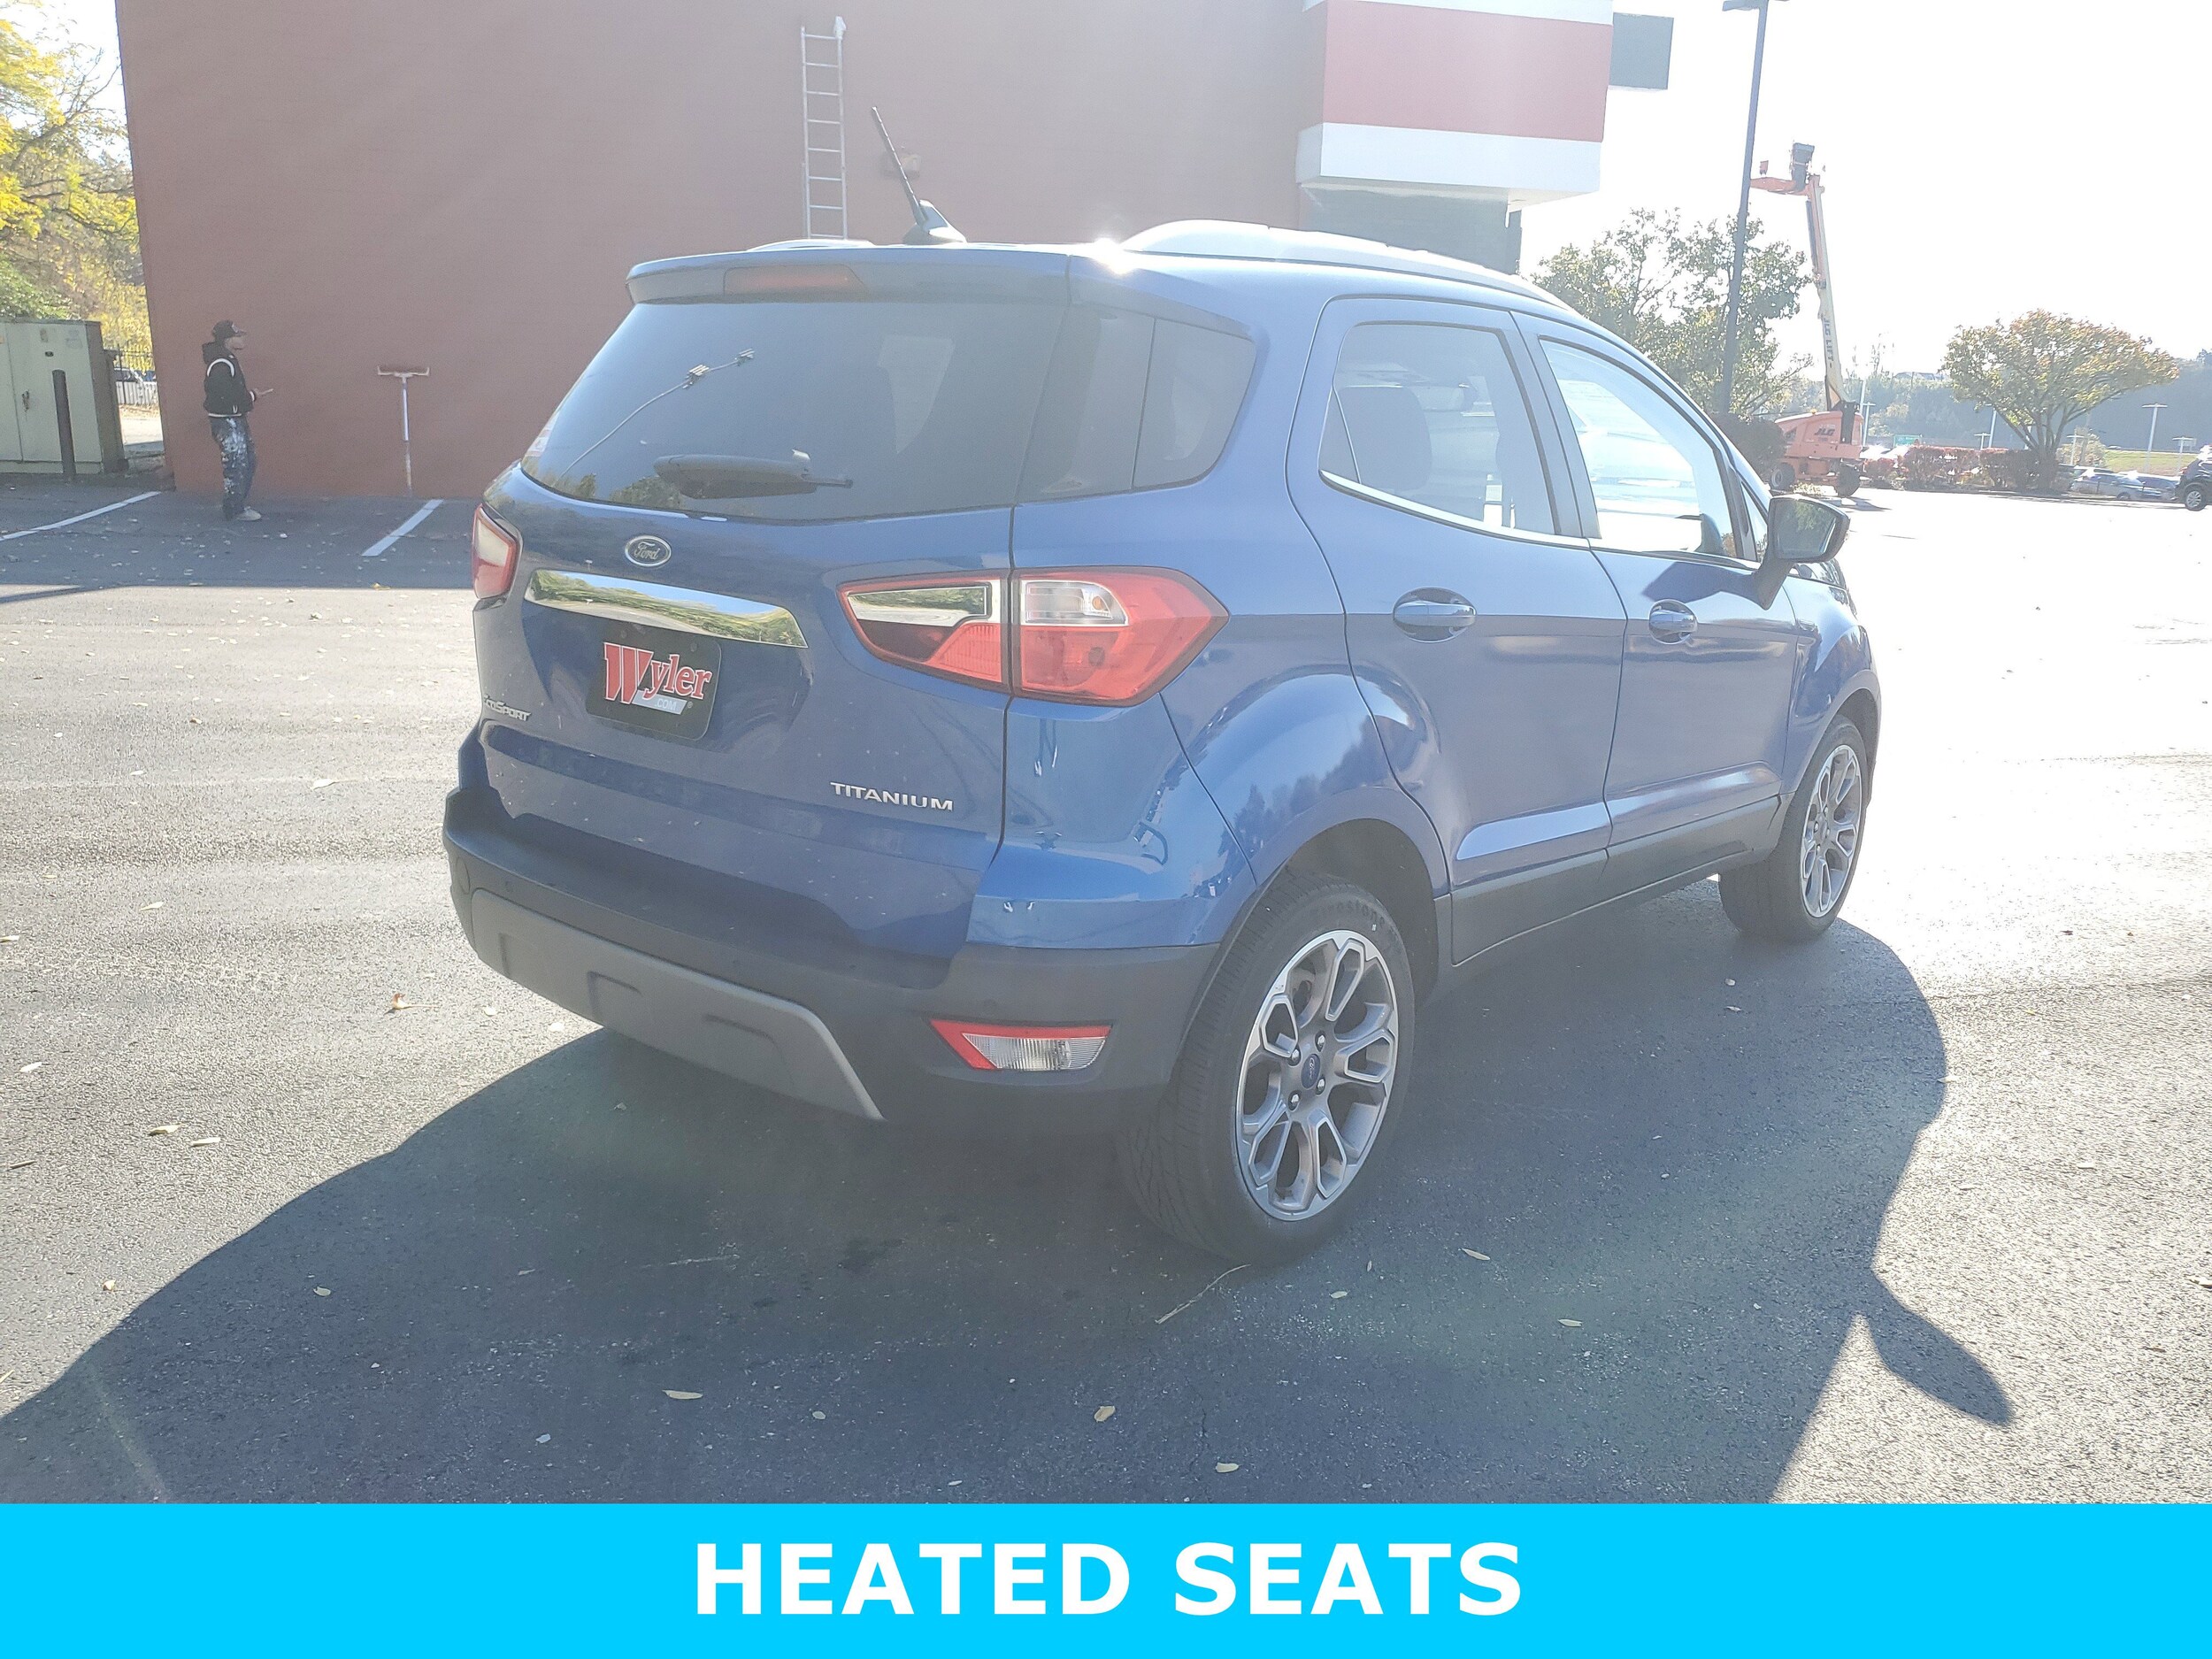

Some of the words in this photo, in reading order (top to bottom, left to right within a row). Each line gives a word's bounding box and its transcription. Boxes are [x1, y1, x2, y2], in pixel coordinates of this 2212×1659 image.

[1814, 427, 1836, 436] JLG
[634, 541, 661, 560] Ford
[603, 641, 712, 704] Wyler
[830, 781, 953, 811] TITANIUM
